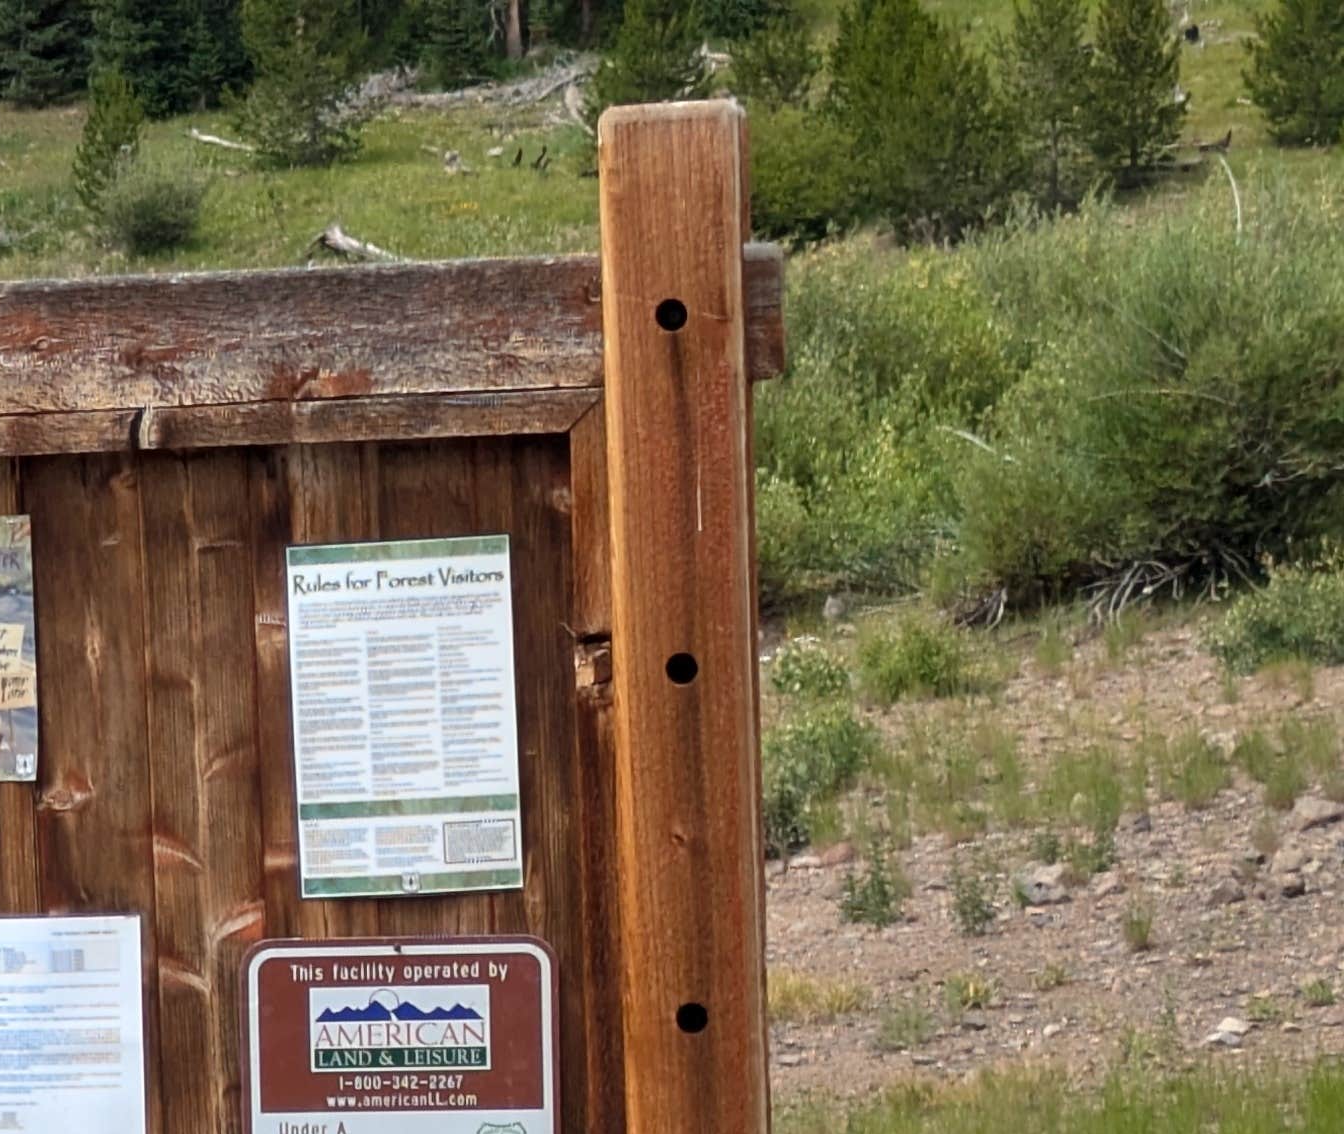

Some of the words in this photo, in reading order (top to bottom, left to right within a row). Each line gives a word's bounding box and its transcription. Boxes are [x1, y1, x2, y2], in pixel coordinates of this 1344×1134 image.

[292, 573, 340, 596] Rules
[346, 571, 372, 590] for
[376, 570, 434, 590] Forest
[438, 566, 505, 587] Visitors
[290, 963, 323, 982] This
[333, 962, 395, 982] facility
[404, 961, 480, 982] operated
[489, 960, 508, 982] by
[315, 1021, 485, 1047] AMERICAN
[319, 1050, 372, 1067] LAND
[379, 1050, 393, 1065] &
[404, 1048, 482, 1065] LEISURE
[339, 1075, 463, 1090] 1-800-342-2267
